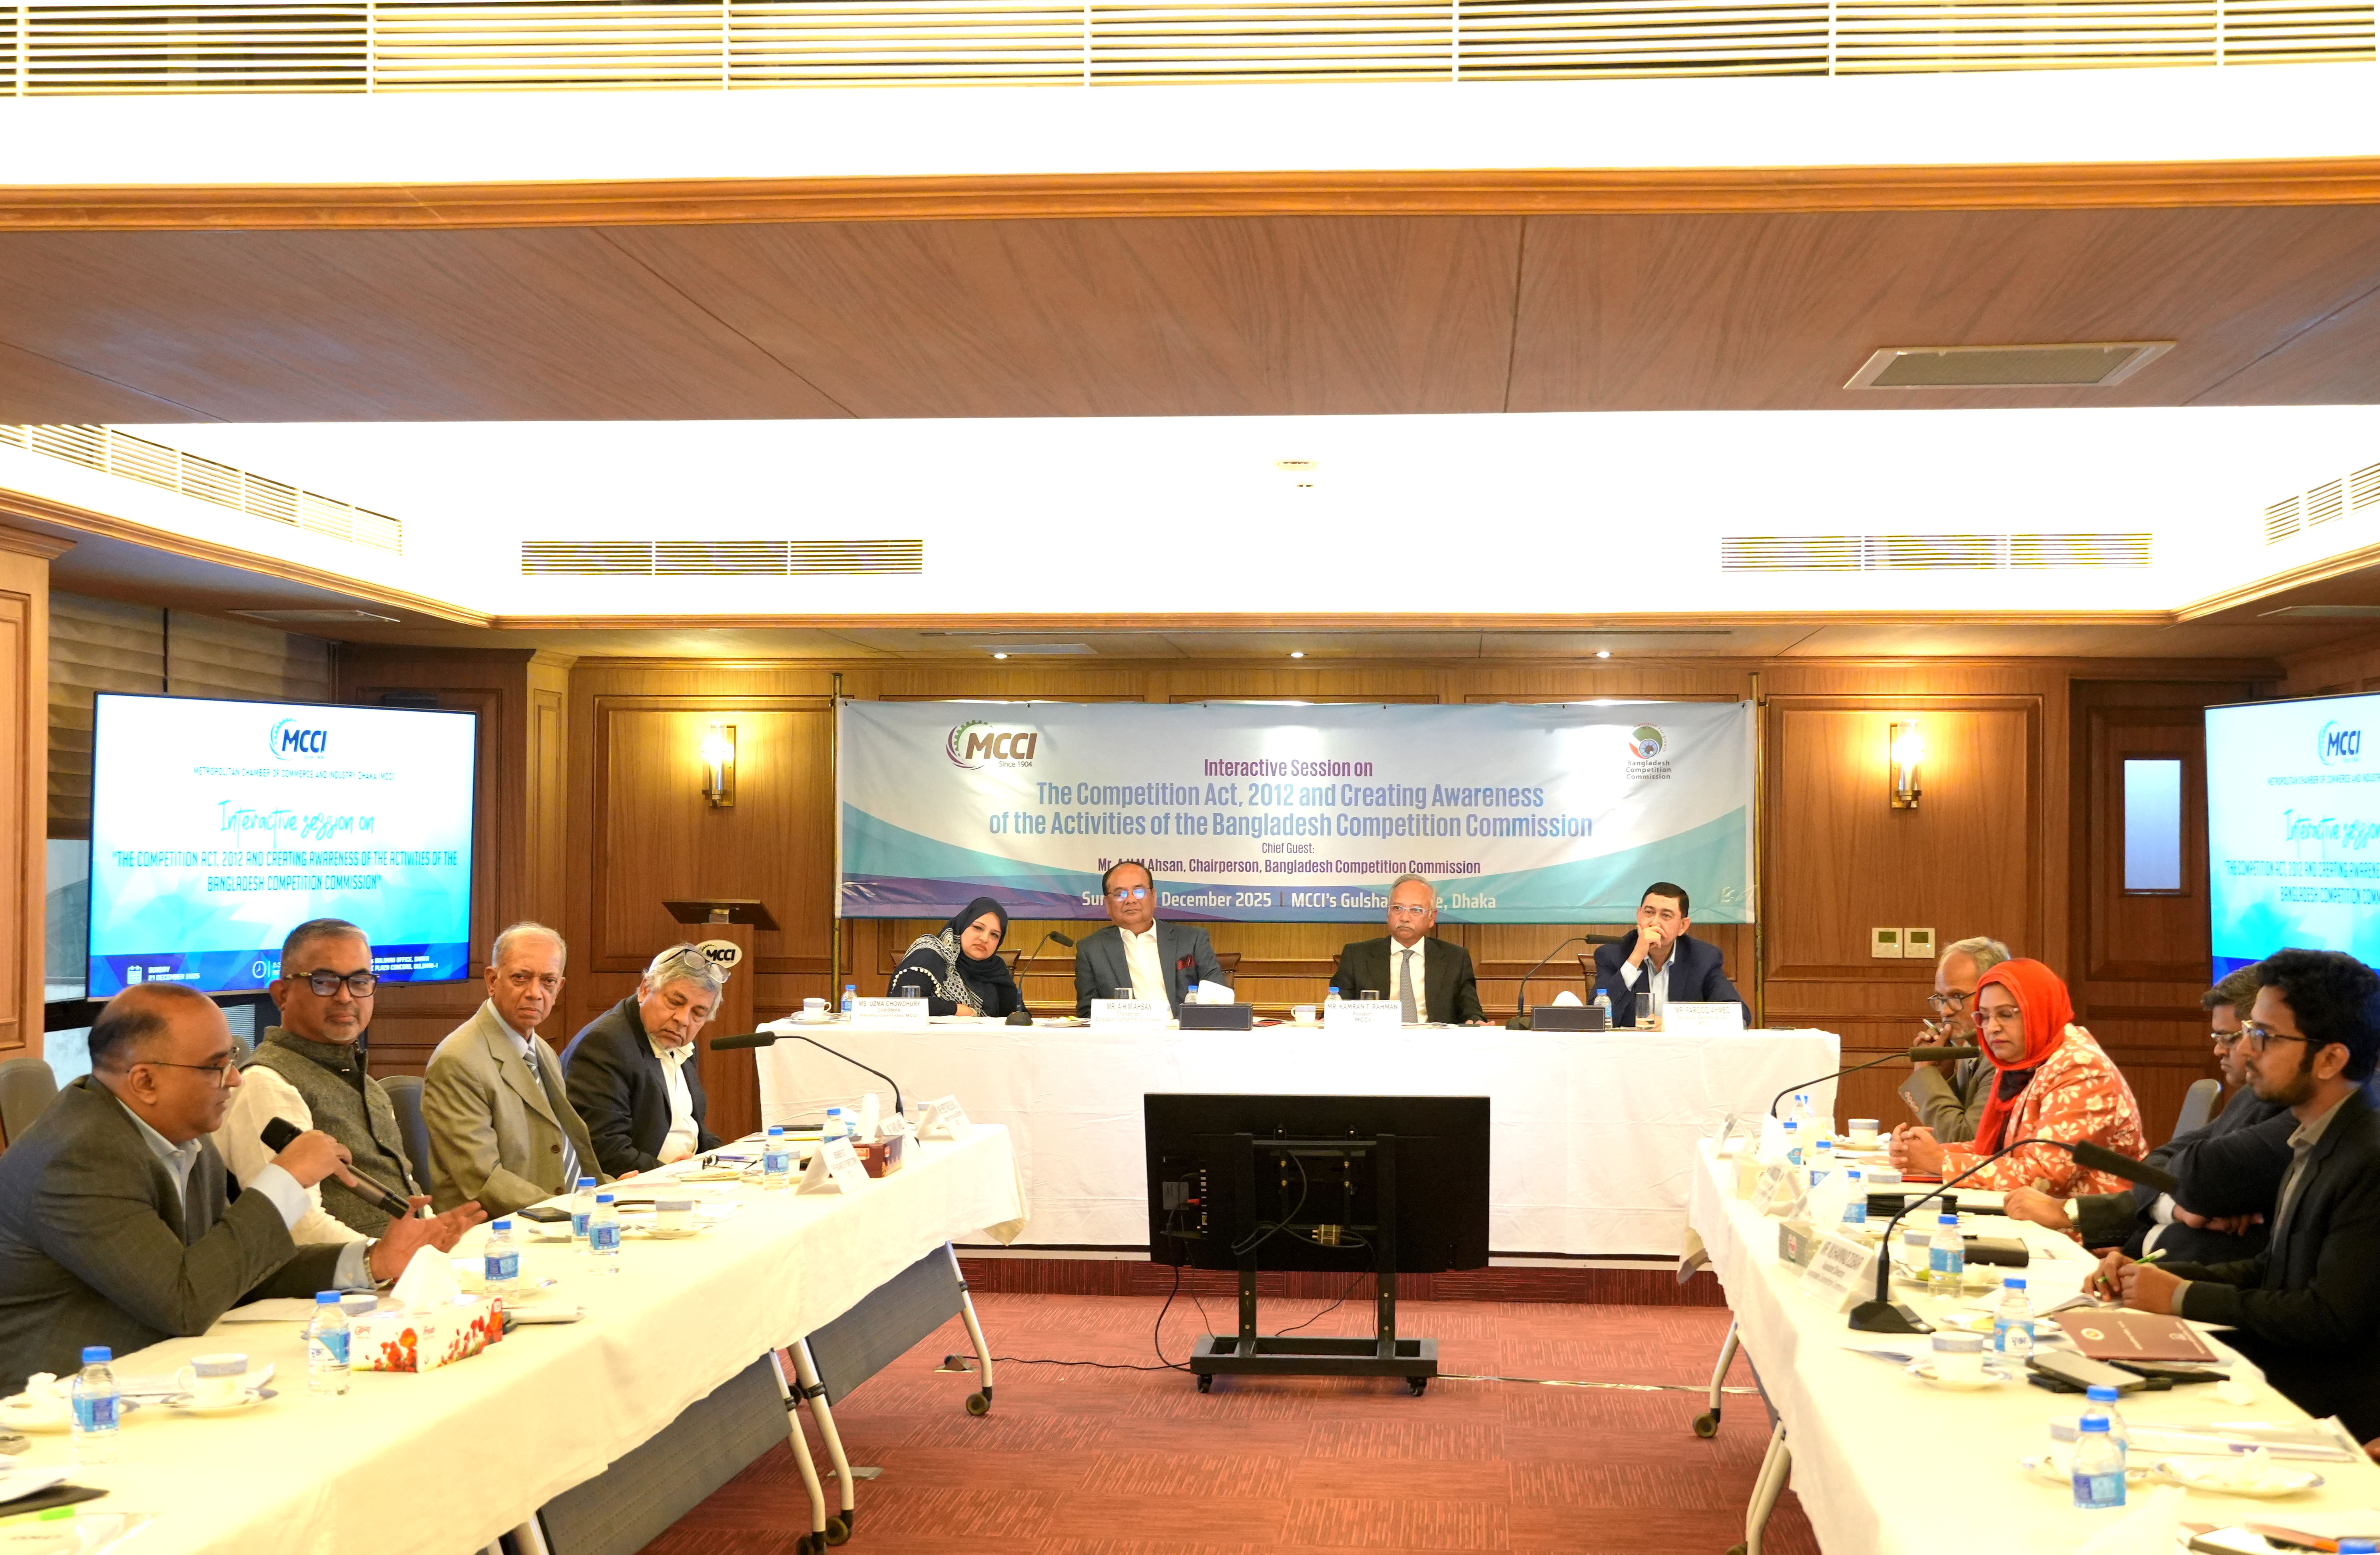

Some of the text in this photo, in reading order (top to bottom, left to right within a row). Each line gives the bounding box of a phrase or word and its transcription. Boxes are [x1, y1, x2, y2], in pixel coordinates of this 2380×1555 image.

[281, 729, 327, 753] MCCI
[965, 733, 1038, 759] MCCI
[2326, 730, 2360, 756] MCCI
[194, 767, 239, 777] METROPOLITAN
[241, 768, 271, 777] CHAMBER
[281, 770, 313, 778] COMMERCE
[379, 772, 395, 781] (MCCI)
[1204, 759, 1373, 777] Interactive Session on
[1037, 782, 1544, 810] The Competition Act, 2012 and Creating Awareness
[217, 800, 375, 849] Interactive session on
[989, 811, 1592, 839] of the Activities of the Bangladesh Competition Commission
[1262, 842, 1315, 854] Chief Guest:
[137, 851, 198, 867] COMPETITION
[201, 851, 219, 868] ACT,
[222, 851, 242, 866] 2012
[246, 851, 263, 866] AND
[267, 851, 307, 866] CREATING
[309, 851, 359, 866] AWARENESS
[361, 851, 372, 866] OF
[374, 851, 387, 866] THE
[390, 851, 430, 866] ACTIVITIES
[432, 851, 441, 866] OF
[444, 851, 458, 866] THE
[1148, 858, 1186, 873] Ahsan,
[1189, 859, 1262, 874] Chairperson,
[1265, 859, 1333, 875] Bangladesh
[1336, 860, 1406, 875] Competition
[1409, 860, 1481, 874] Commission
[207, 876, 264, 891] BANGLADESH
[267, 875, 322, 890] COMPETITION
[1162, 892, 1232, 907] December
[1236, 892, 1272, 907] 2025
[1341, 892, 1388, 908] Gulsha
[1452, 894, 1496, 909] Dhaka
[706, 949, 736, 961] MCCI
